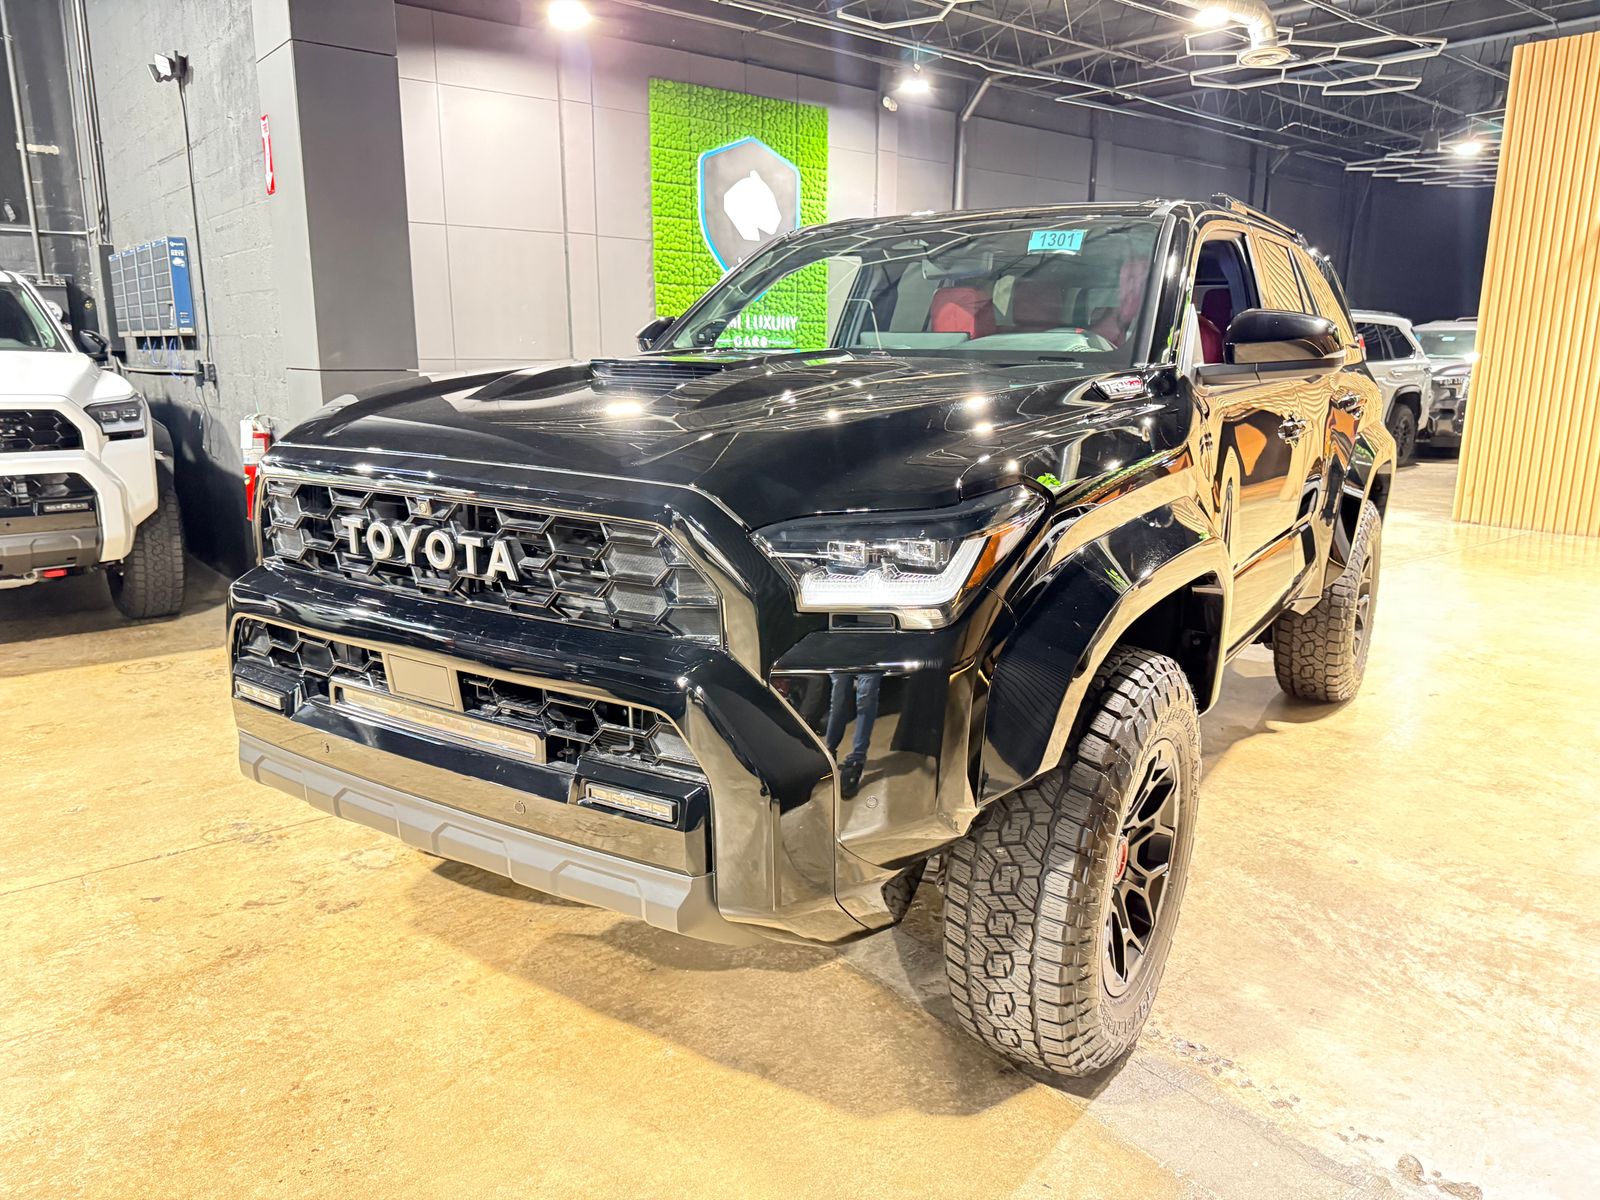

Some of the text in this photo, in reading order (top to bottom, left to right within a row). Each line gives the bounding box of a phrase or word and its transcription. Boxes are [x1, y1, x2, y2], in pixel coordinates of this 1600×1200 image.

[1040, 232, 1075, 247] 1301
[745, 314, 799, 331] LUXURY
[733, 335, 768, 348] CARS
[340, 516, 520, 584] TOYOTA
